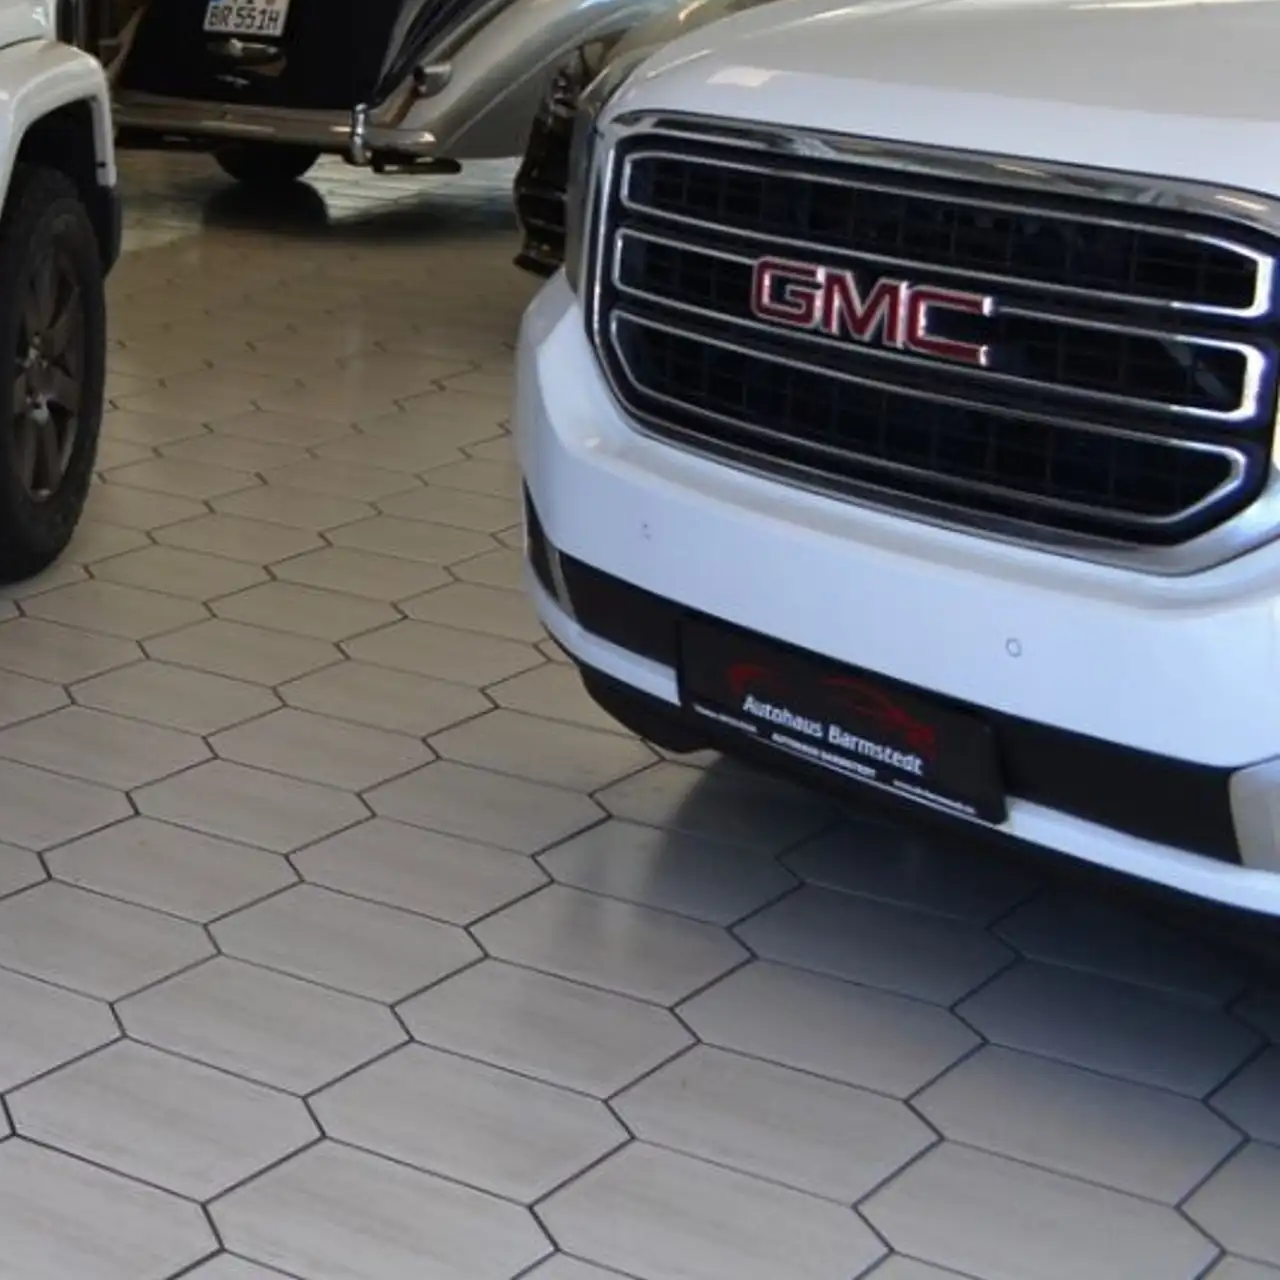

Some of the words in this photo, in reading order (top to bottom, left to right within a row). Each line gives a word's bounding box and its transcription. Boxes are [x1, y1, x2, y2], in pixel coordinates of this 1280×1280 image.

[751, 256, 993, 367] GMC
[742, 693, 823, 739] Autohaus
[827, 723, 924, 777] Barmstedt
